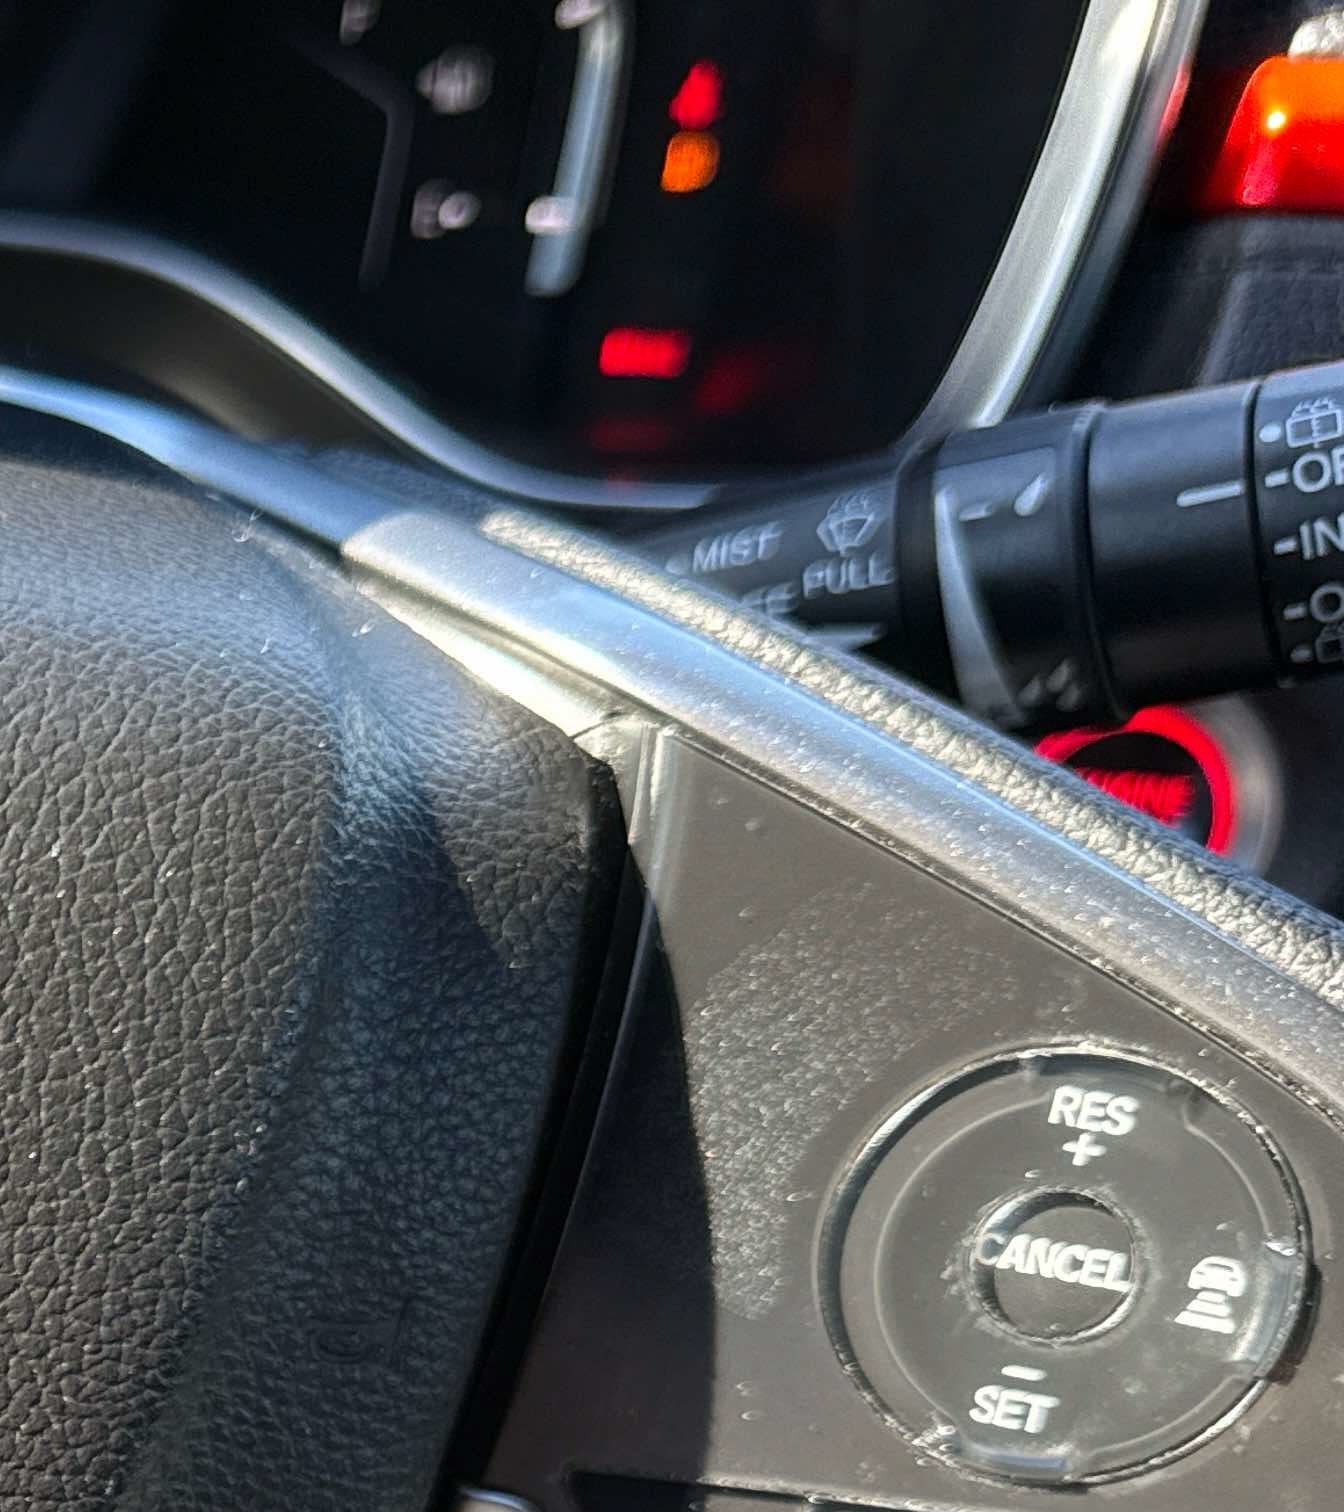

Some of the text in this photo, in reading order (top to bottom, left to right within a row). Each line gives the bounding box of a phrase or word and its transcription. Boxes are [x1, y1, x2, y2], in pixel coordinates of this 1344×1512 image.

[692, 520, 786, 574] MIST
[803, 550, 897, 598] PULL
[1047, 1084, 1139, 1136] RES
[974, 1232, 1134, 1293] CANCEL
[968, 1384, 1061, 1434] SET
